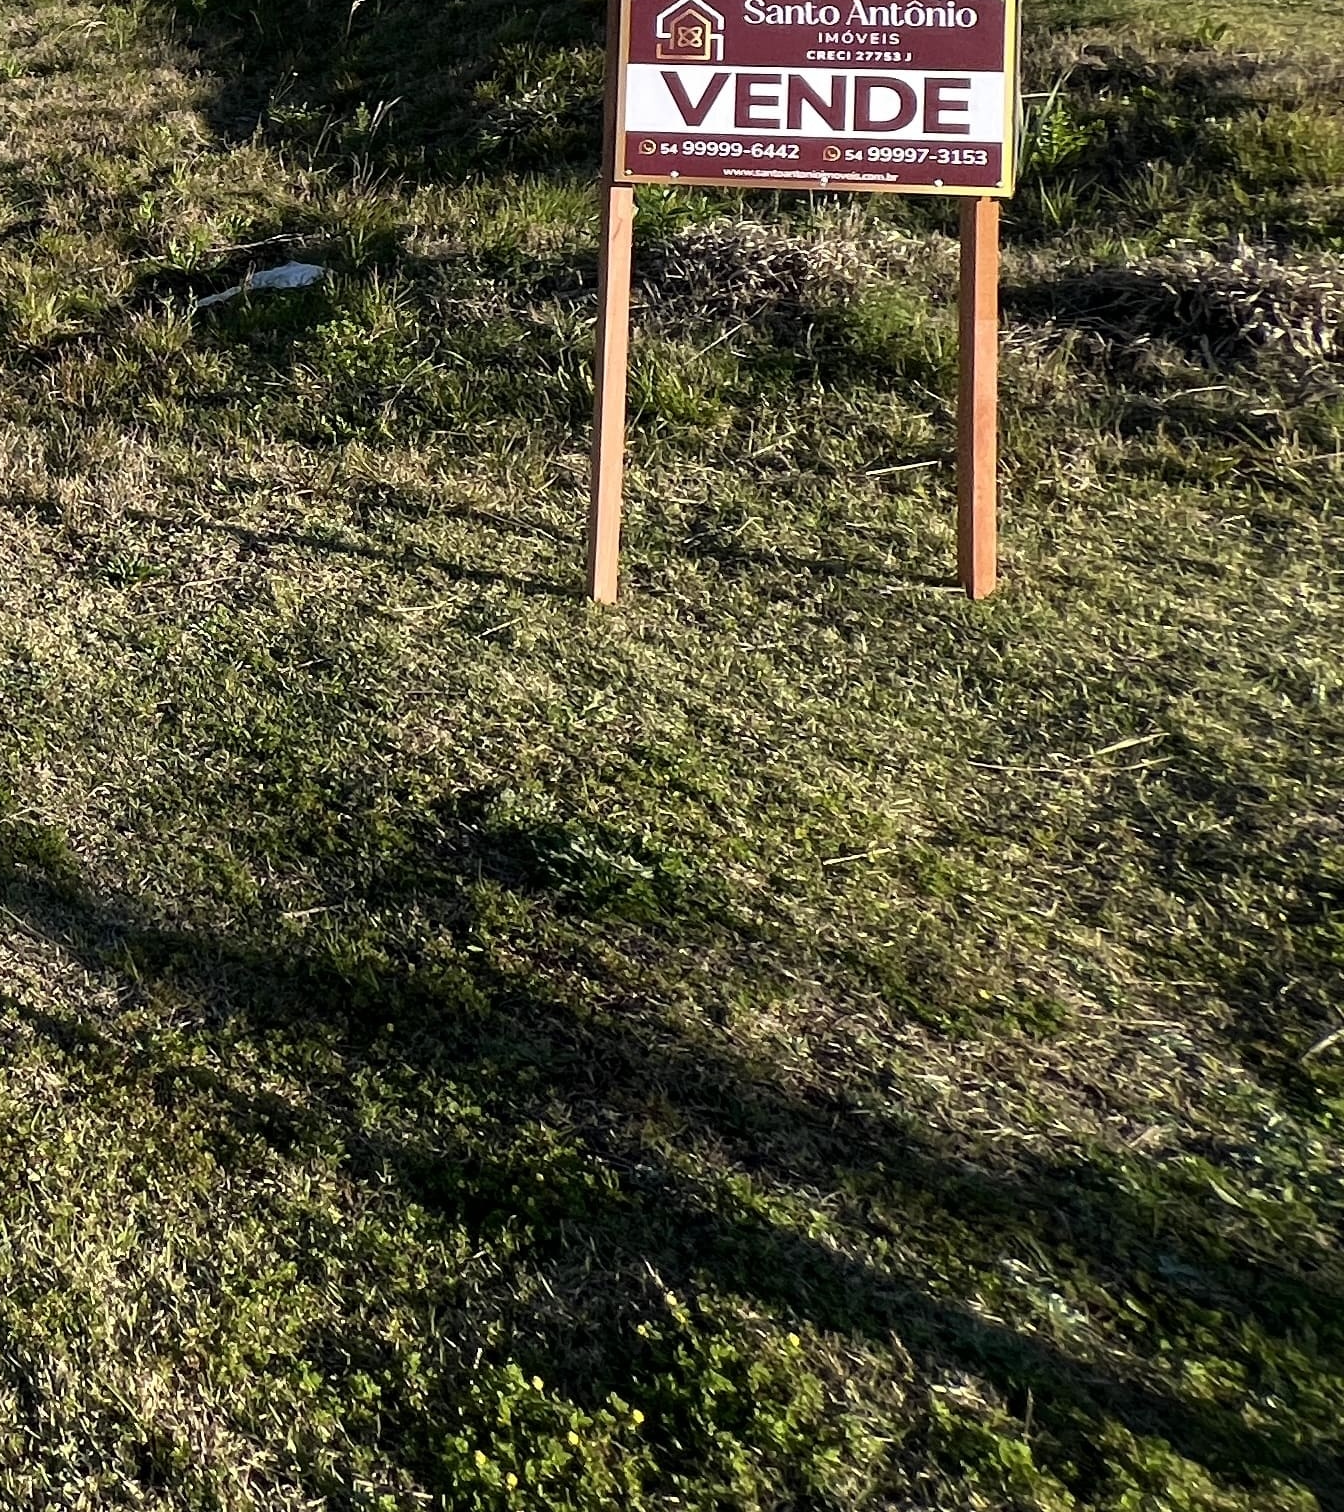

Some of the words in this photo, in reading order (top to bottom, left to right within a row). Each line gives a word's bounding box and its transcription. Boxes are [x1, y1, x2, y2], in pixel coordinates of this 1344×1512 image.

[845, 0, 978, 28] Antônio
[818, 30, 901, 45] IMÓVEIS
[806, 50, 851, 61] CRECI
[855, 51, 902, 62] 27753
[904, 52, 912, 62] J
[661, 71, 971, 134] VENDE
[660, 144, 678, 155] 54
[682, 142, 800, 160] 99999-6442
[845, 150, 863, 162] 54
[867, 147, 988, 165] 99997-3153
